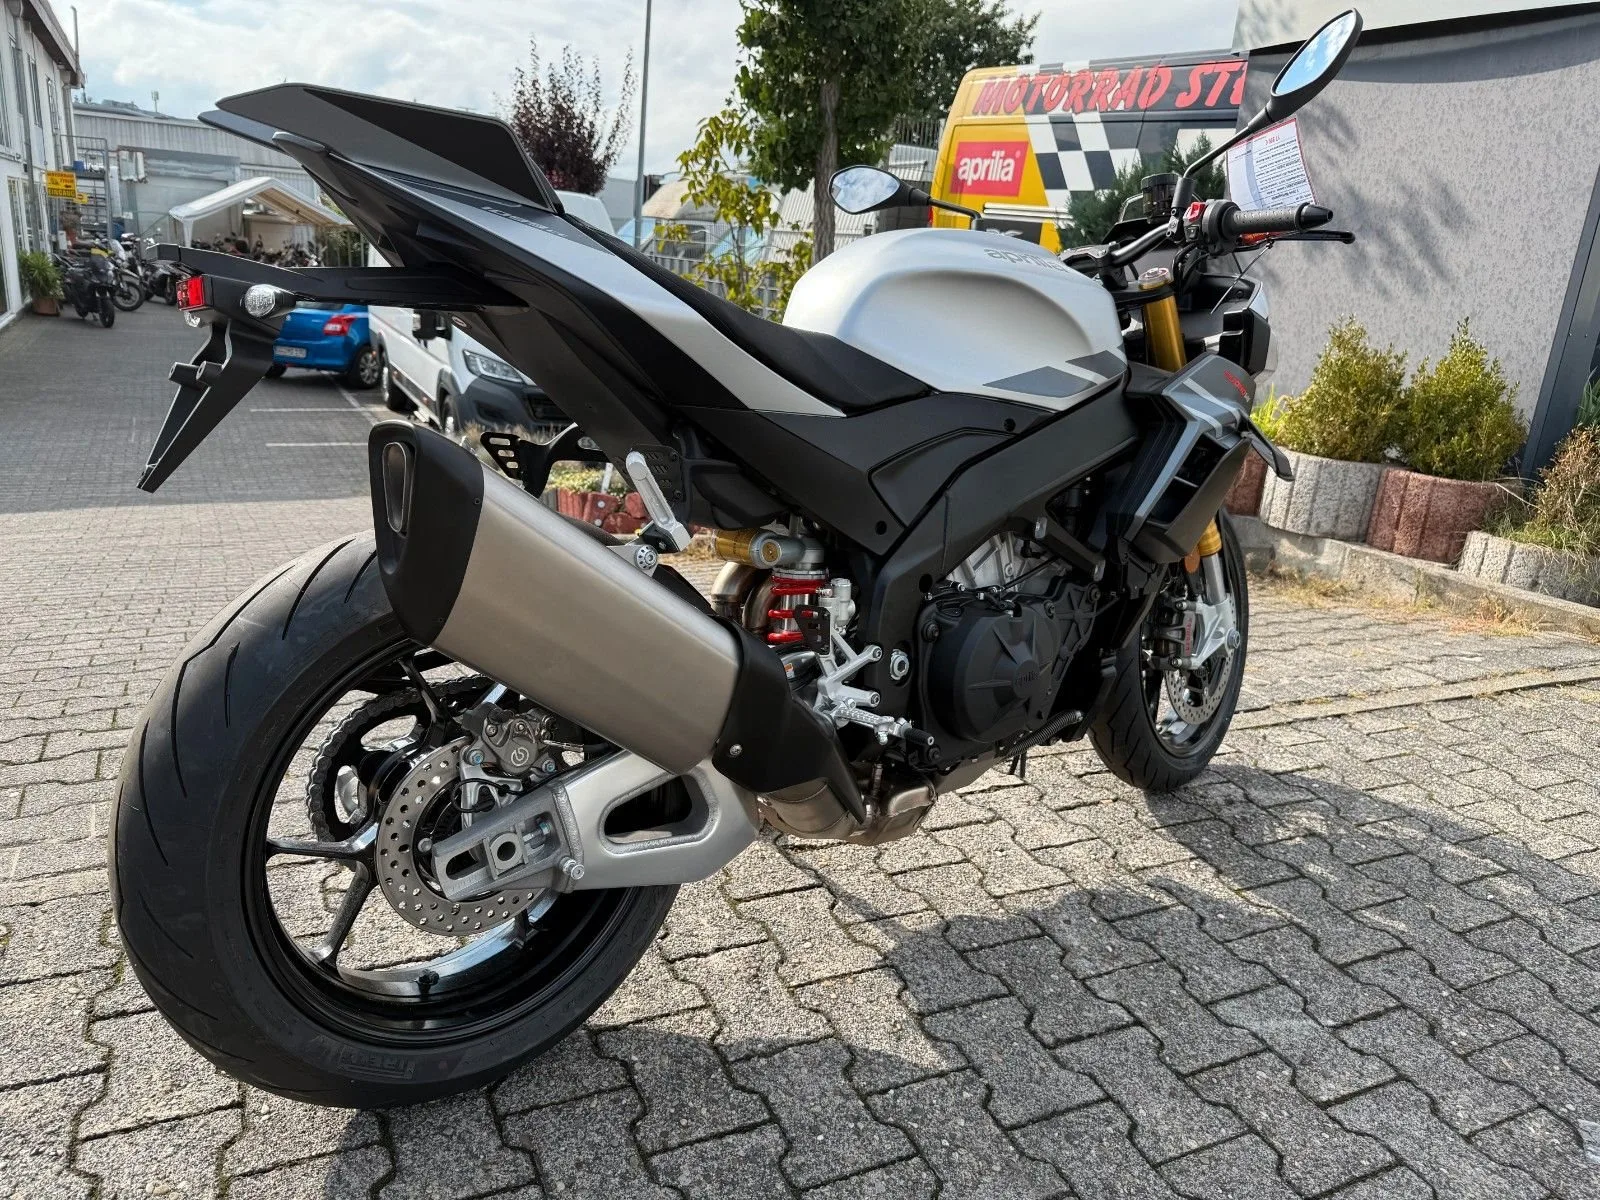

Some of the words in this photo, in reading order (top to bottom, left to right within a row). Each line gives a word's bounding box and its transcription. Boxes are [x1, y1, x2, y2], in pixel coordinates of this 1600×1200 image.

[972, 66, 1171, 115] MOTORRAD
[957, 150, 1016, 187] aprilia
[983, 247, 1070, 274] aprilia
